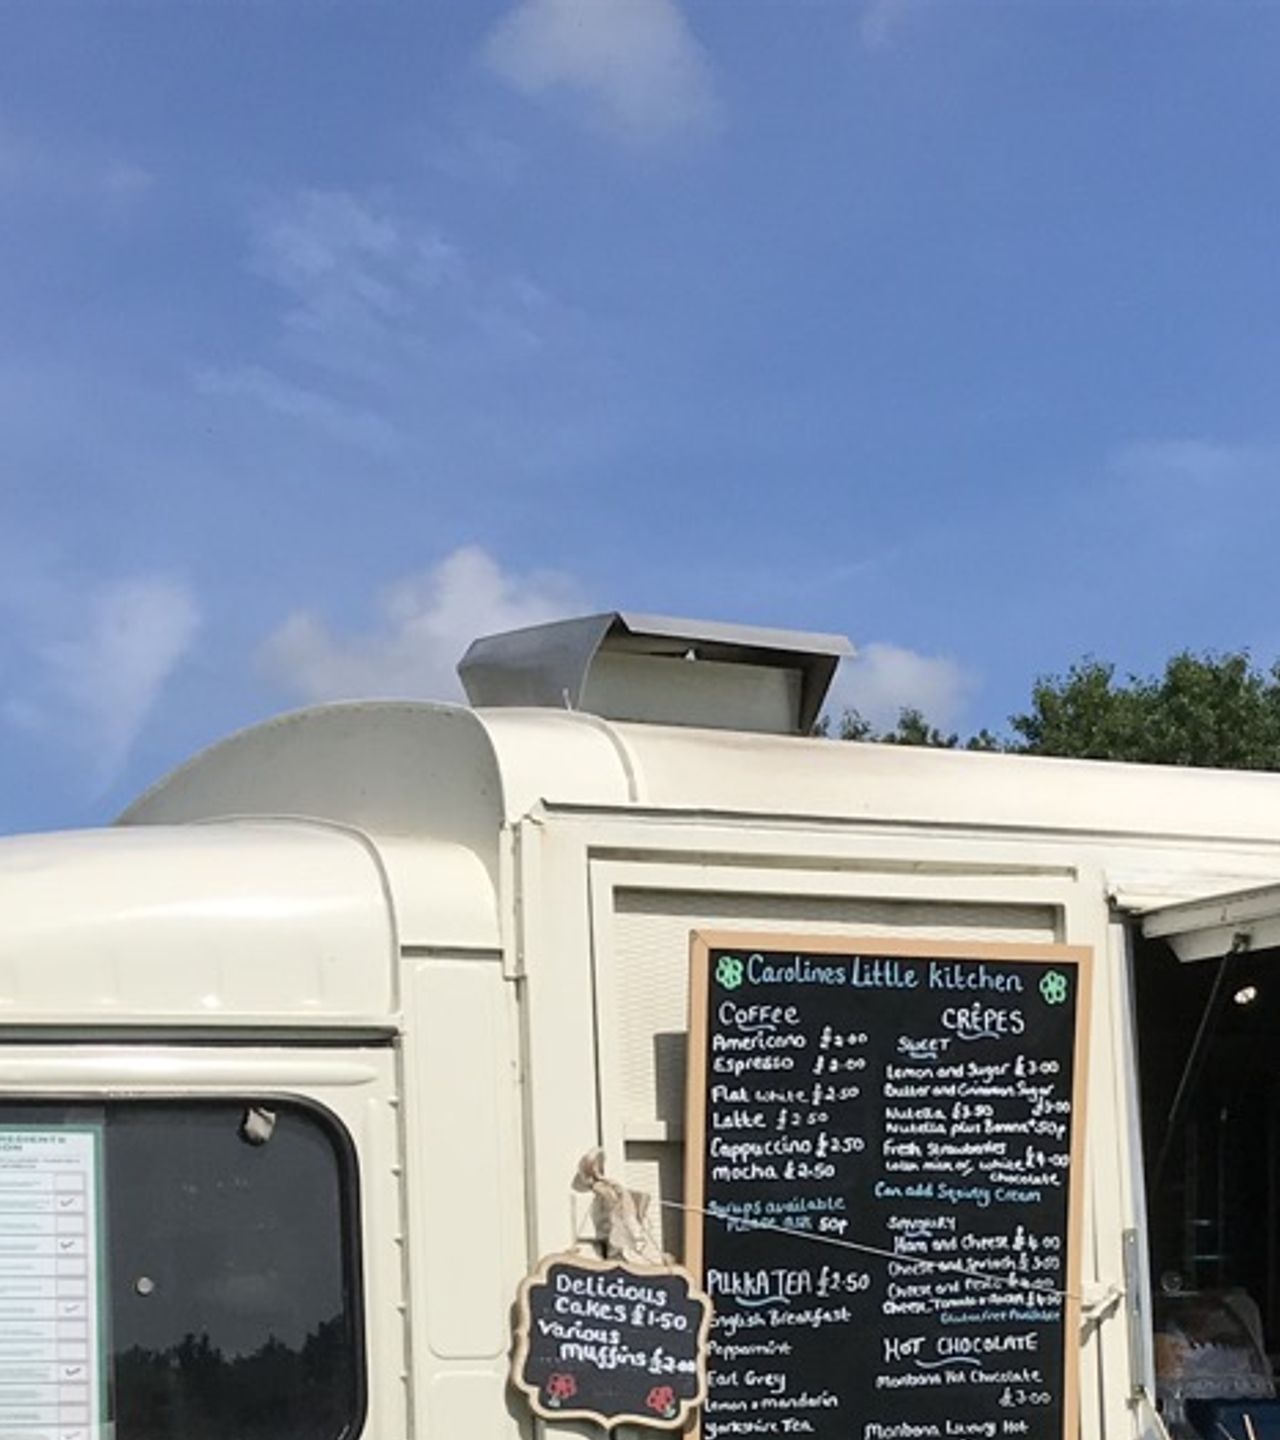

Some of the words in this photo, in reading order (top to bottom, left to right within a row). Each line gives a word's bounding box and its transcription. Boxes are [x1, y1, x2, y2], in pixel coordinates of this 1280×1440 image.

[746, 953, 847, 985] Carolines
[851, 956, 918, 988] Little
[712, 1030, 807, 1050] Americano
[713, 1056, 795, 1077] Espresso
[936, 1063, 964, 1078] and
[967, 1062, 1011, 1083] Sugar
[711, 1085, 749, 1103] Flat
[932, 1083, 956, 1097] and
[713, 1110, 767, 1129] Latte
[709, 1135, 813, 1163] Cappuccino
[904, 1182, 934, 1197] add
[556, 1273, 668, 1307] Delicious
[816, 1265, 870, 1298] £2.50
[554, 1296, 627, 1322] Cakes
[744, 1370, 787, 1394] Grey
